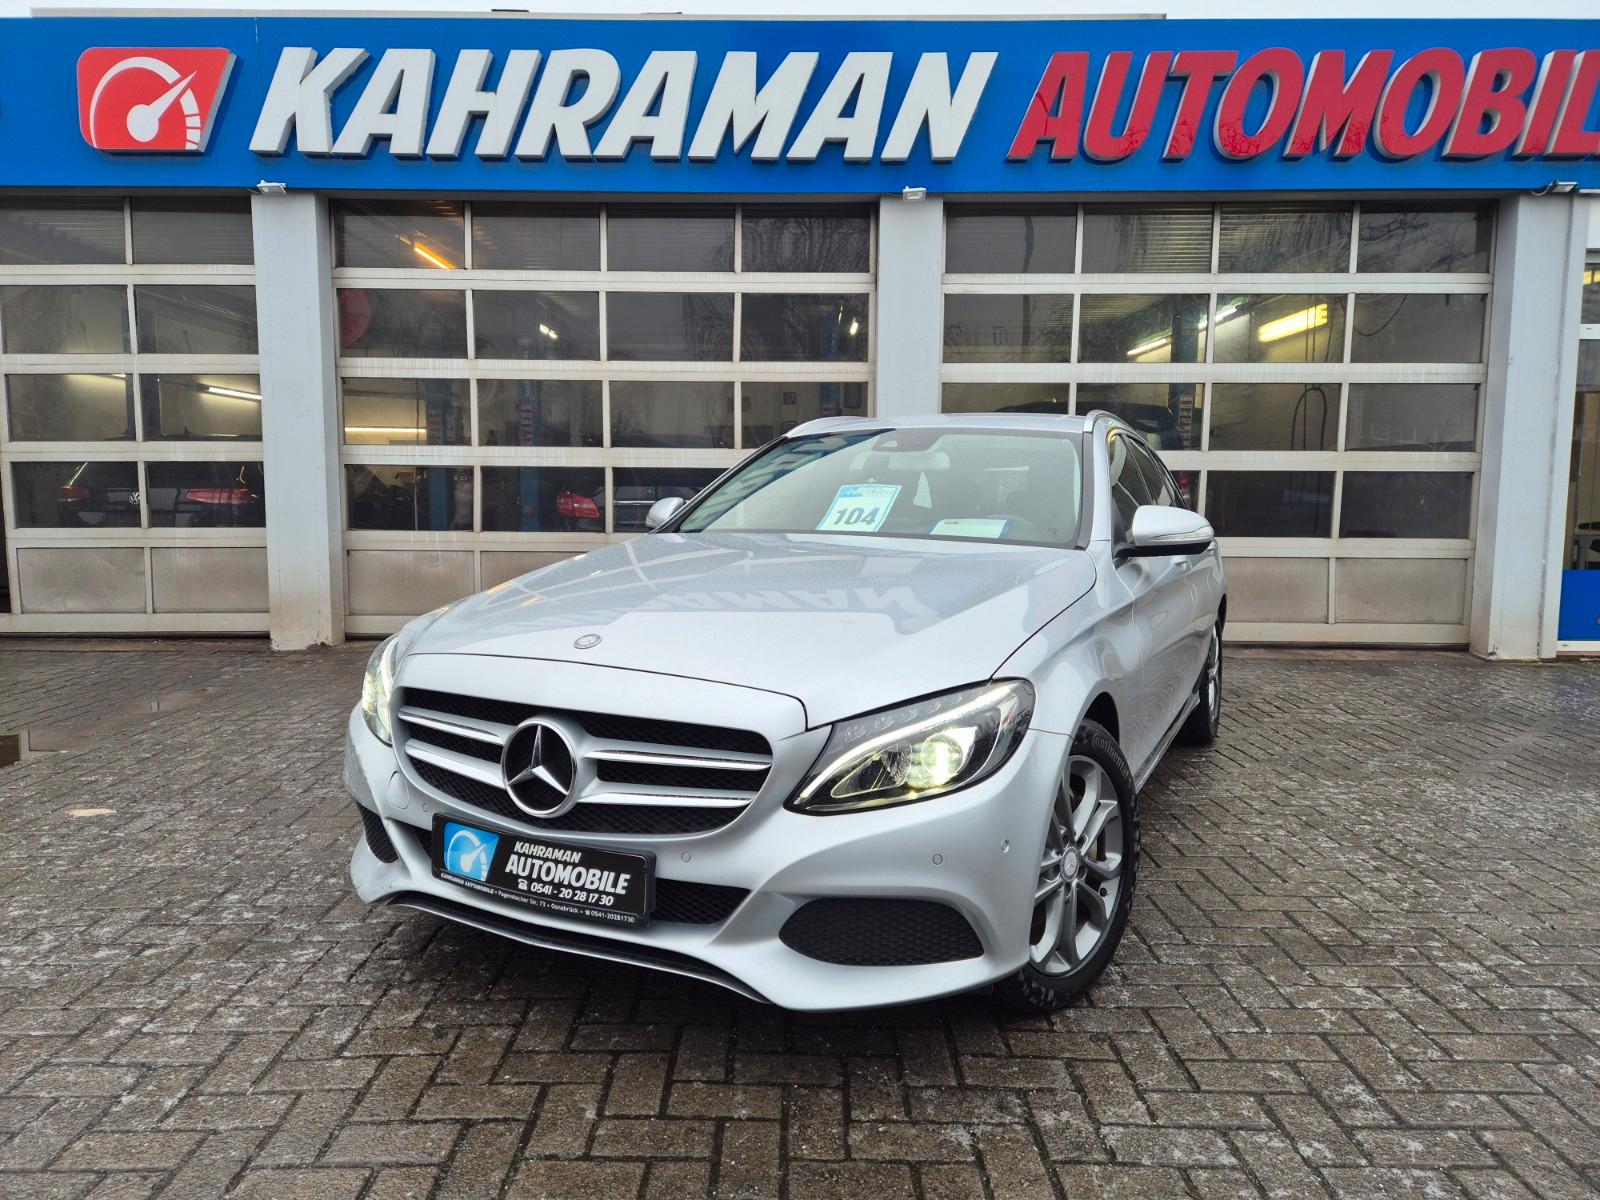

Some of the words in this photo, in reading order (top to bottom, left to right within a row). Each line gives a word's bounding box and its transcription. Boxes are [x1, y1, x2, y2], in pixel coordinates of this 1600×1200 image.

[249, 47, 998, 162] KAHRAMAN
[834, 507, 880, 526] 104
[513, 840, 582, 864] KAHRAMAN
[504, 853, 631, 895] AUTOMOBILE
[530, 881, 553, 896] 0541
[558, 887, 573, 899] 20
[573, 890, 588, 902] 28
[588, 893, 599, 904] 17
[598, 894, 614, 907] 30
